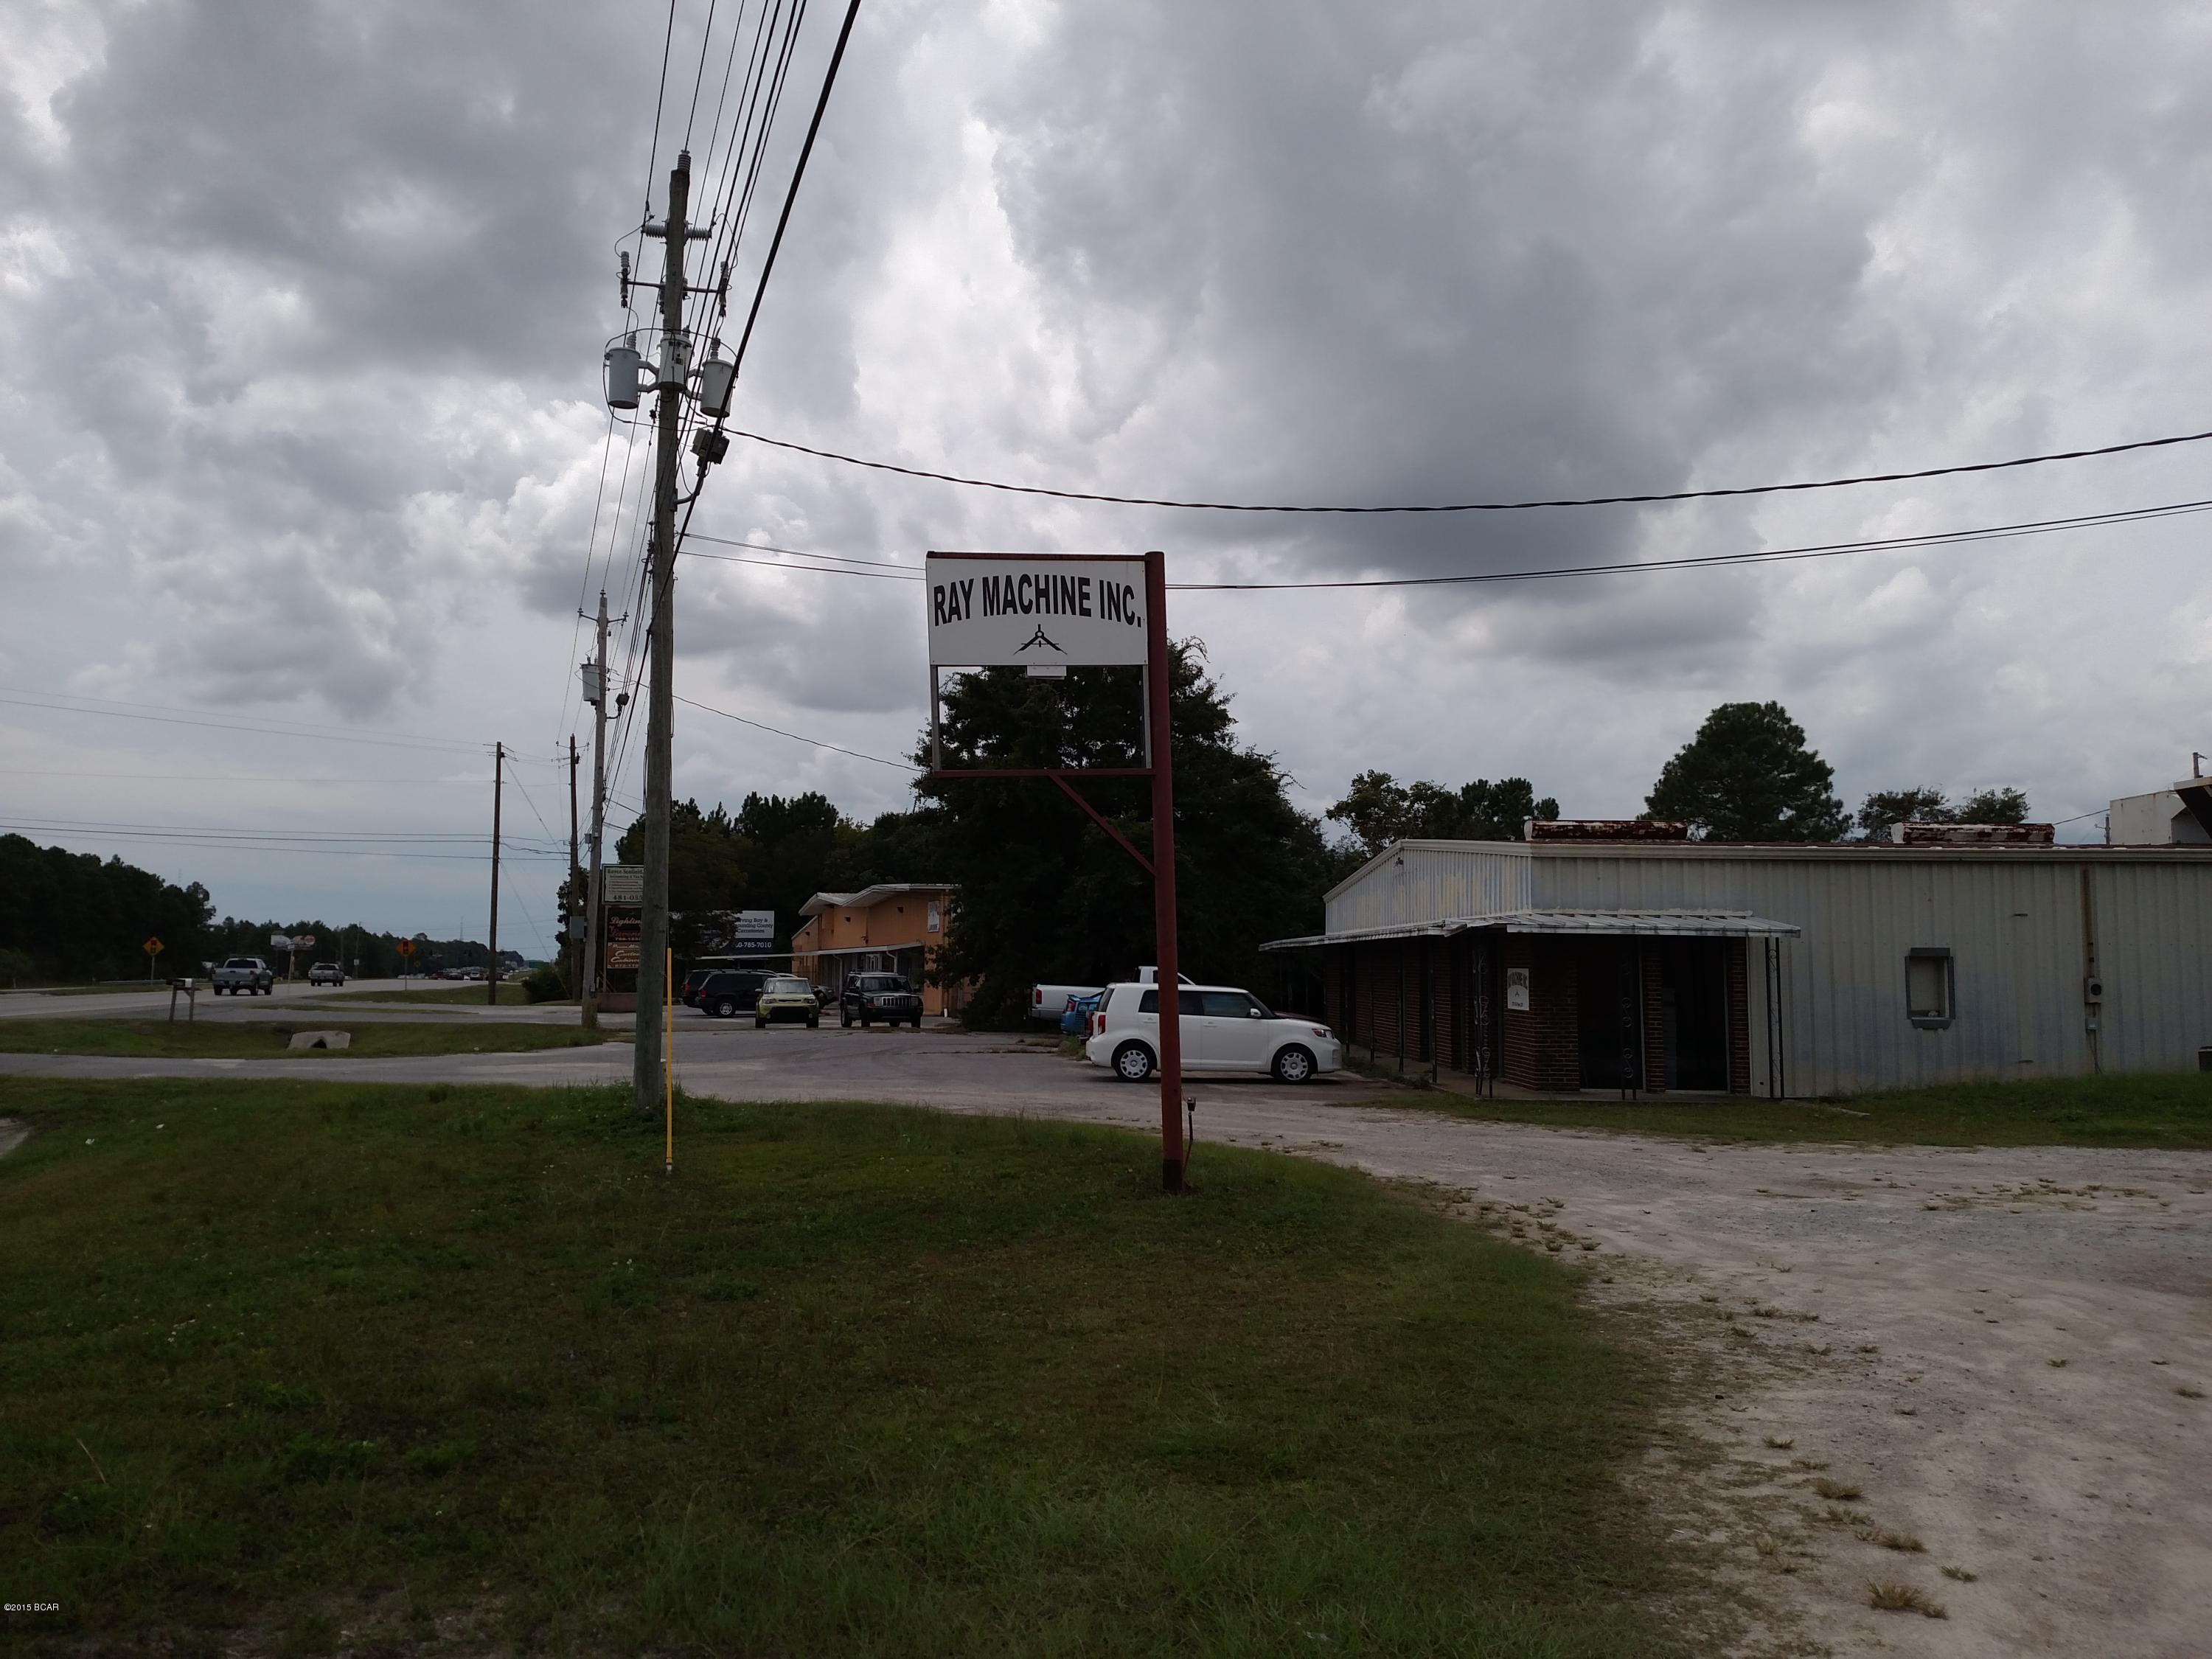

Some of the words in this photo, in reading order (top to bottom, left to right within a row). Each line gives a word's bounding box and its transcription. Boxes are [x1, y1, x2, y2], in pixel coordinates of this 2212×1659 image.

[933, 578, 974, 627] RAY
[982, 574, 1092, 617] MACHINE
[1099, 580, 1142, 628] INC.
